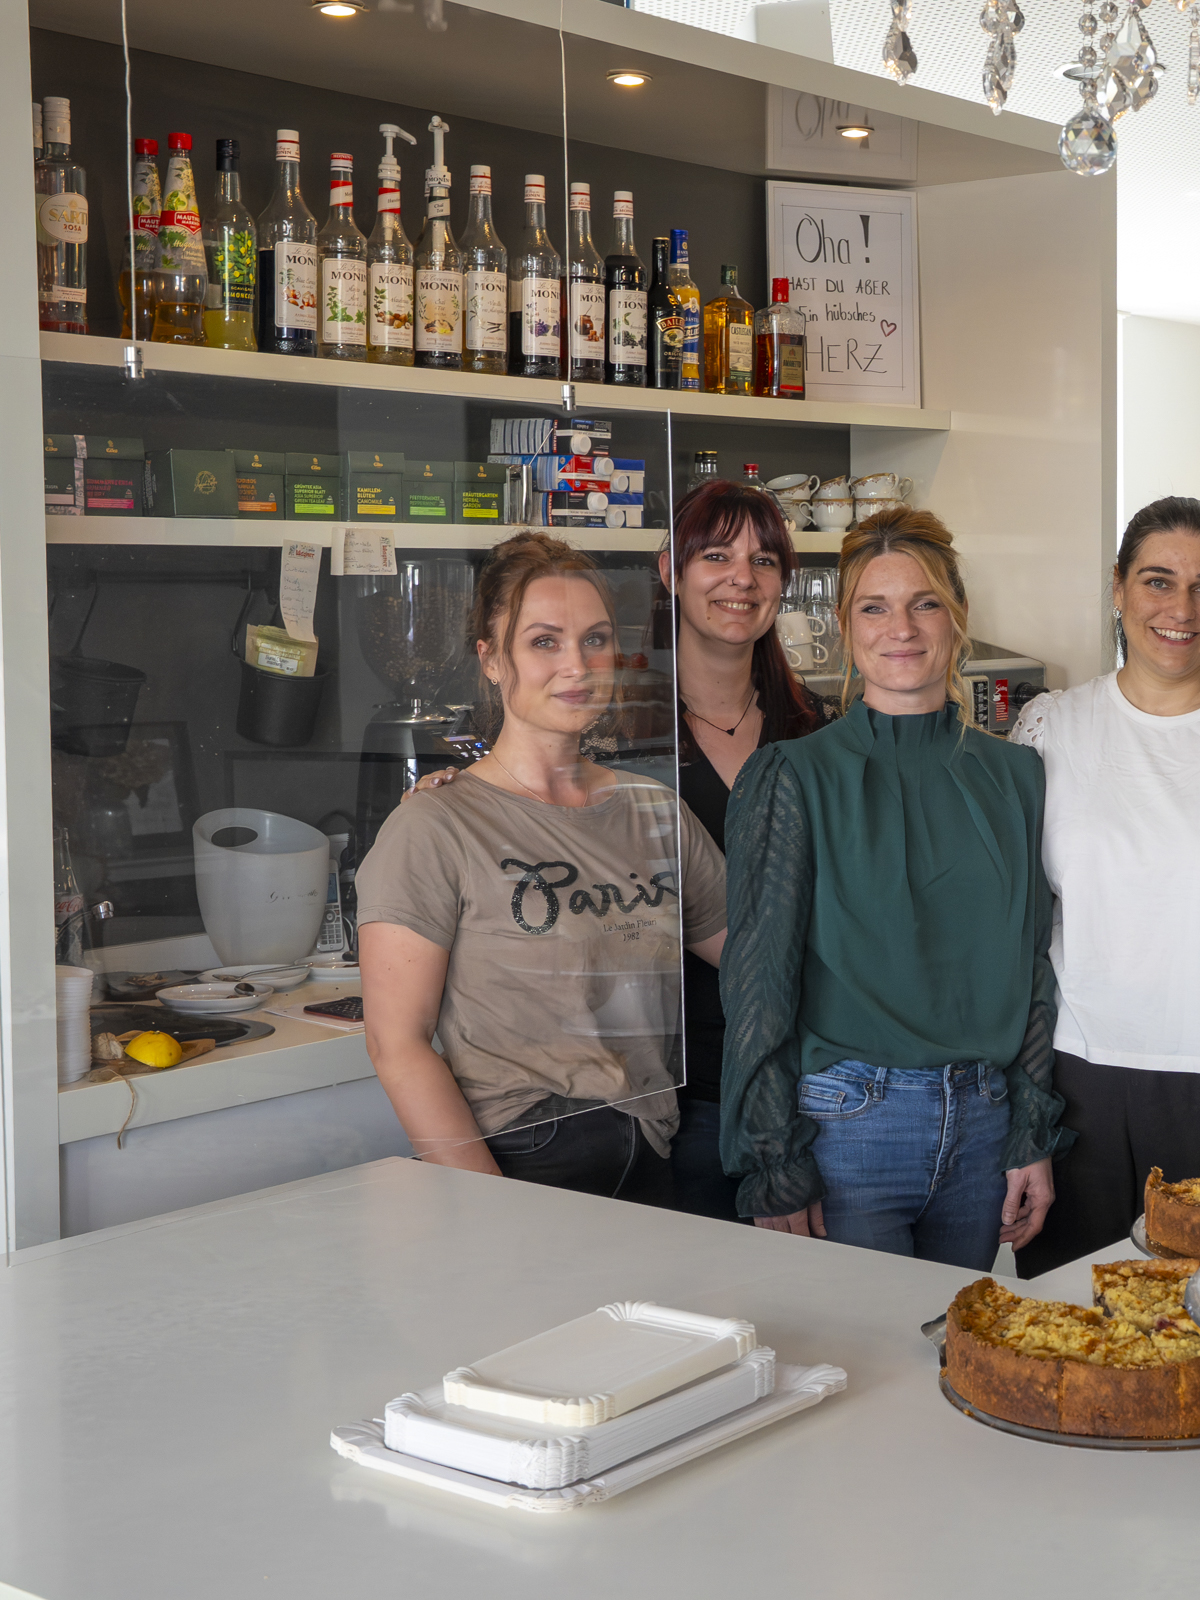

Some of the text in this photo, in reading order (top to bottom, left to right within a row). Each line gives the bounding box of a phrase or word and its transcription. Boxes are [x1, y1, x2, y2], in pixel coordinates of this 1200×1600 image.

[62, 223, 82, 232] ROSA
[420, 282, 460, 292] MONIN
[786, 276, 891, 296] HAST DU ABER
[799, 302, 876, 323] Ein hübsches
[660, 318, 684, 329] BAILE
[804, 335, 888, 374] HERZ
[501, 858, 679, 936] Paris
[603, 918, 658, 933] Le Jardin Fleuri
[622, 932, 641, 942] 1982
